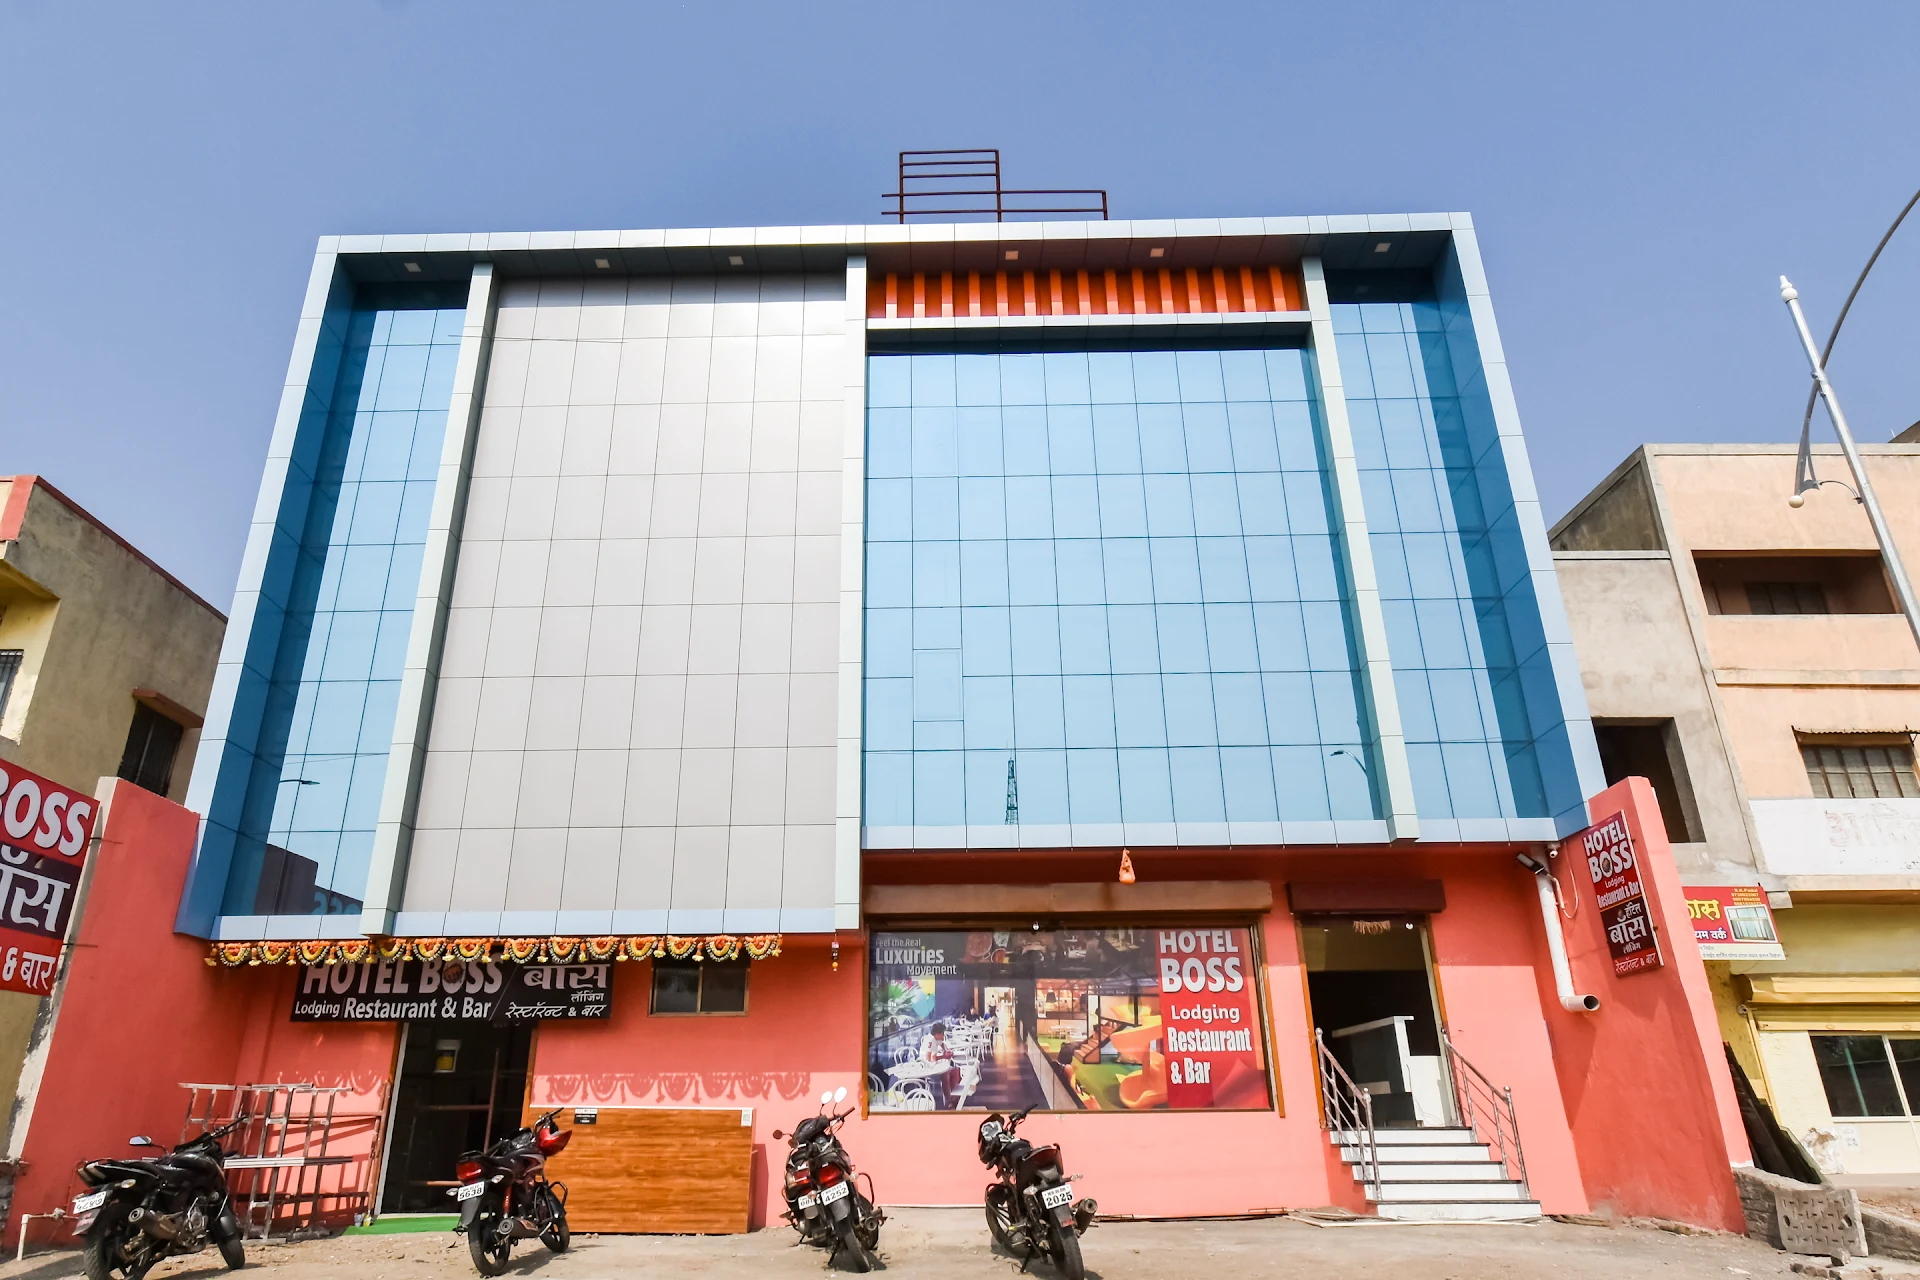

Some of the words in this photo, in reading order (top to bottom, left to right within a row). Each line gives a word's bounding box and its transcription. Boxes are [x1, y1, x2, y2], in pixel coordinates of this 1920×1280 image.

[1583, 820, 1626, 857] HOTEL
[1588, 840, 1633, 884] BOSS
[1604, 875, 1626, 889] Lodging
[1597, 886, 1626, 908] Restaurant
[1624, 885, 1631, 898] &
[1628, 881, 1640, 896] Bar
[1608, 914, 1647, 944] बॉस
[875, 938, 890, 947] Feel
[892, 939, 904, 947] the
[905, 938, 921, 947] Real
[1159, 930, 1239, 953] HOTEL
[875, 945, 945, 965] Luxuries
[1646, 953, 1656, 964] बार
[2, 947, 18, 982] &
[21, 952, 56, 990] बार
[303, 954, 409, 994] HOTEL
[419, 952, 503, 994] BOSS
[906, 964, 957, 976] Movement
[1160, 957, 1244, 993] BOSS
[570, 990, 604, 1002] लॉजिंग
[294, 1000, 341, 1019] Lodging
[343, 997, 438, 1019] Restaurant
[441, 996, 457, 1018] &
[462, 997, 492, 1018] Bar
[568, 1007, 577, 1017] &
[581, 1004, 607, 1017] बार
[1171, 1004, 1240, 1024] Lodging
[1167, 1027, 1253, 1052] Restaurant
[1170, 1061, 1183, 1085] &
[1183, 1057, 1211, 1084] Bar
[459, 1187, 483, 1199] 5638
[825, 1187, 848, 1202] 4252
[1046, 1191, 1073, 1207] 2025
